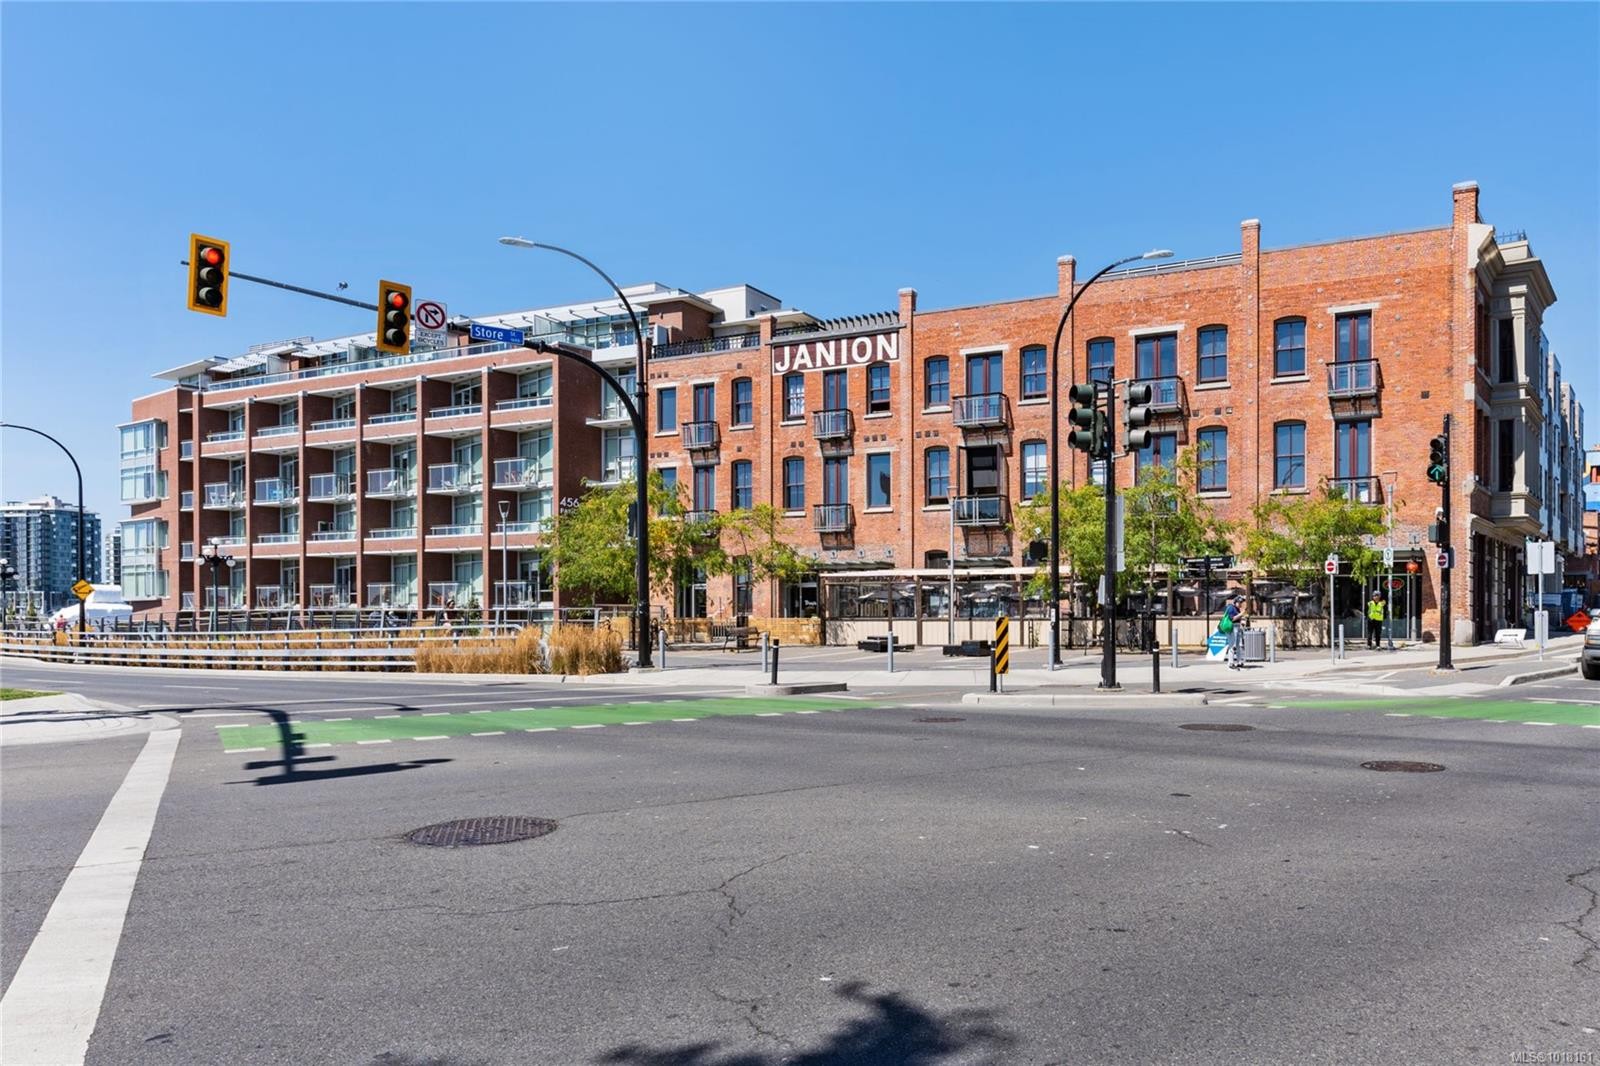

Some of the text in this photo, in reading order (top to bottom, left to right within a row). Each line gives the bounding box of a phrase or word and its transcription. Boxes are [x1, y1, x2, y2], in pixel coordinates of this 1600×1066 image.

[475, 326, 504, 340] Store
[775, 333, 898, 371] JANION
[560, 496, 580, 508] 456
